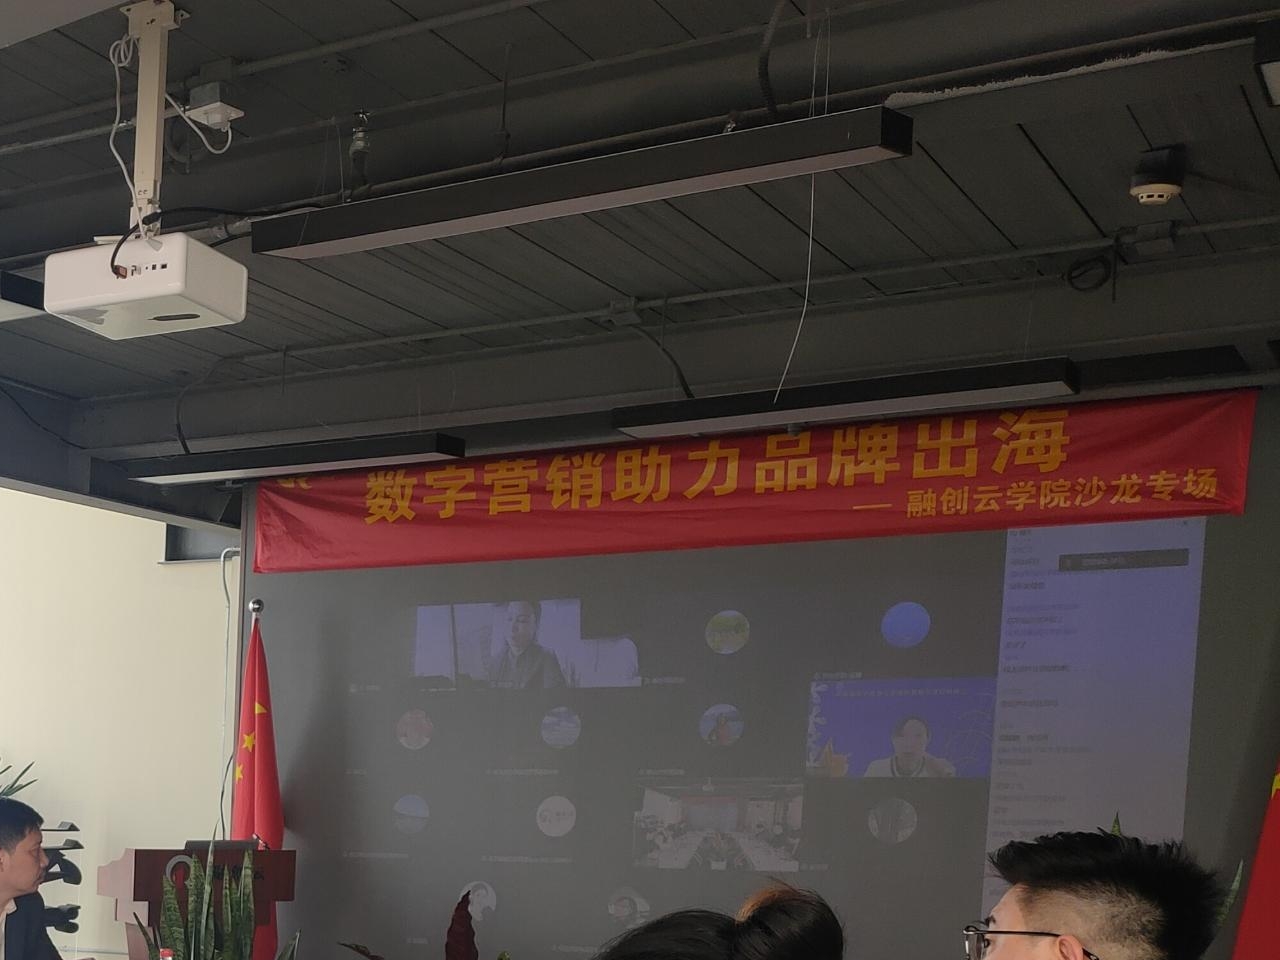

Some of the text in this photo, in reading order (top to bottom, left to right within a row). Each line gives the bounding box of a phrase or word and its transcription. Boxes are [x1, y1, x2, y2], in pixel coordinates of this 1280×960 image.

[364, 409, 1071, 525] 数字营销助力品牌出海
[906, 466, 1218, 519] 融创云学院沙龙专场
